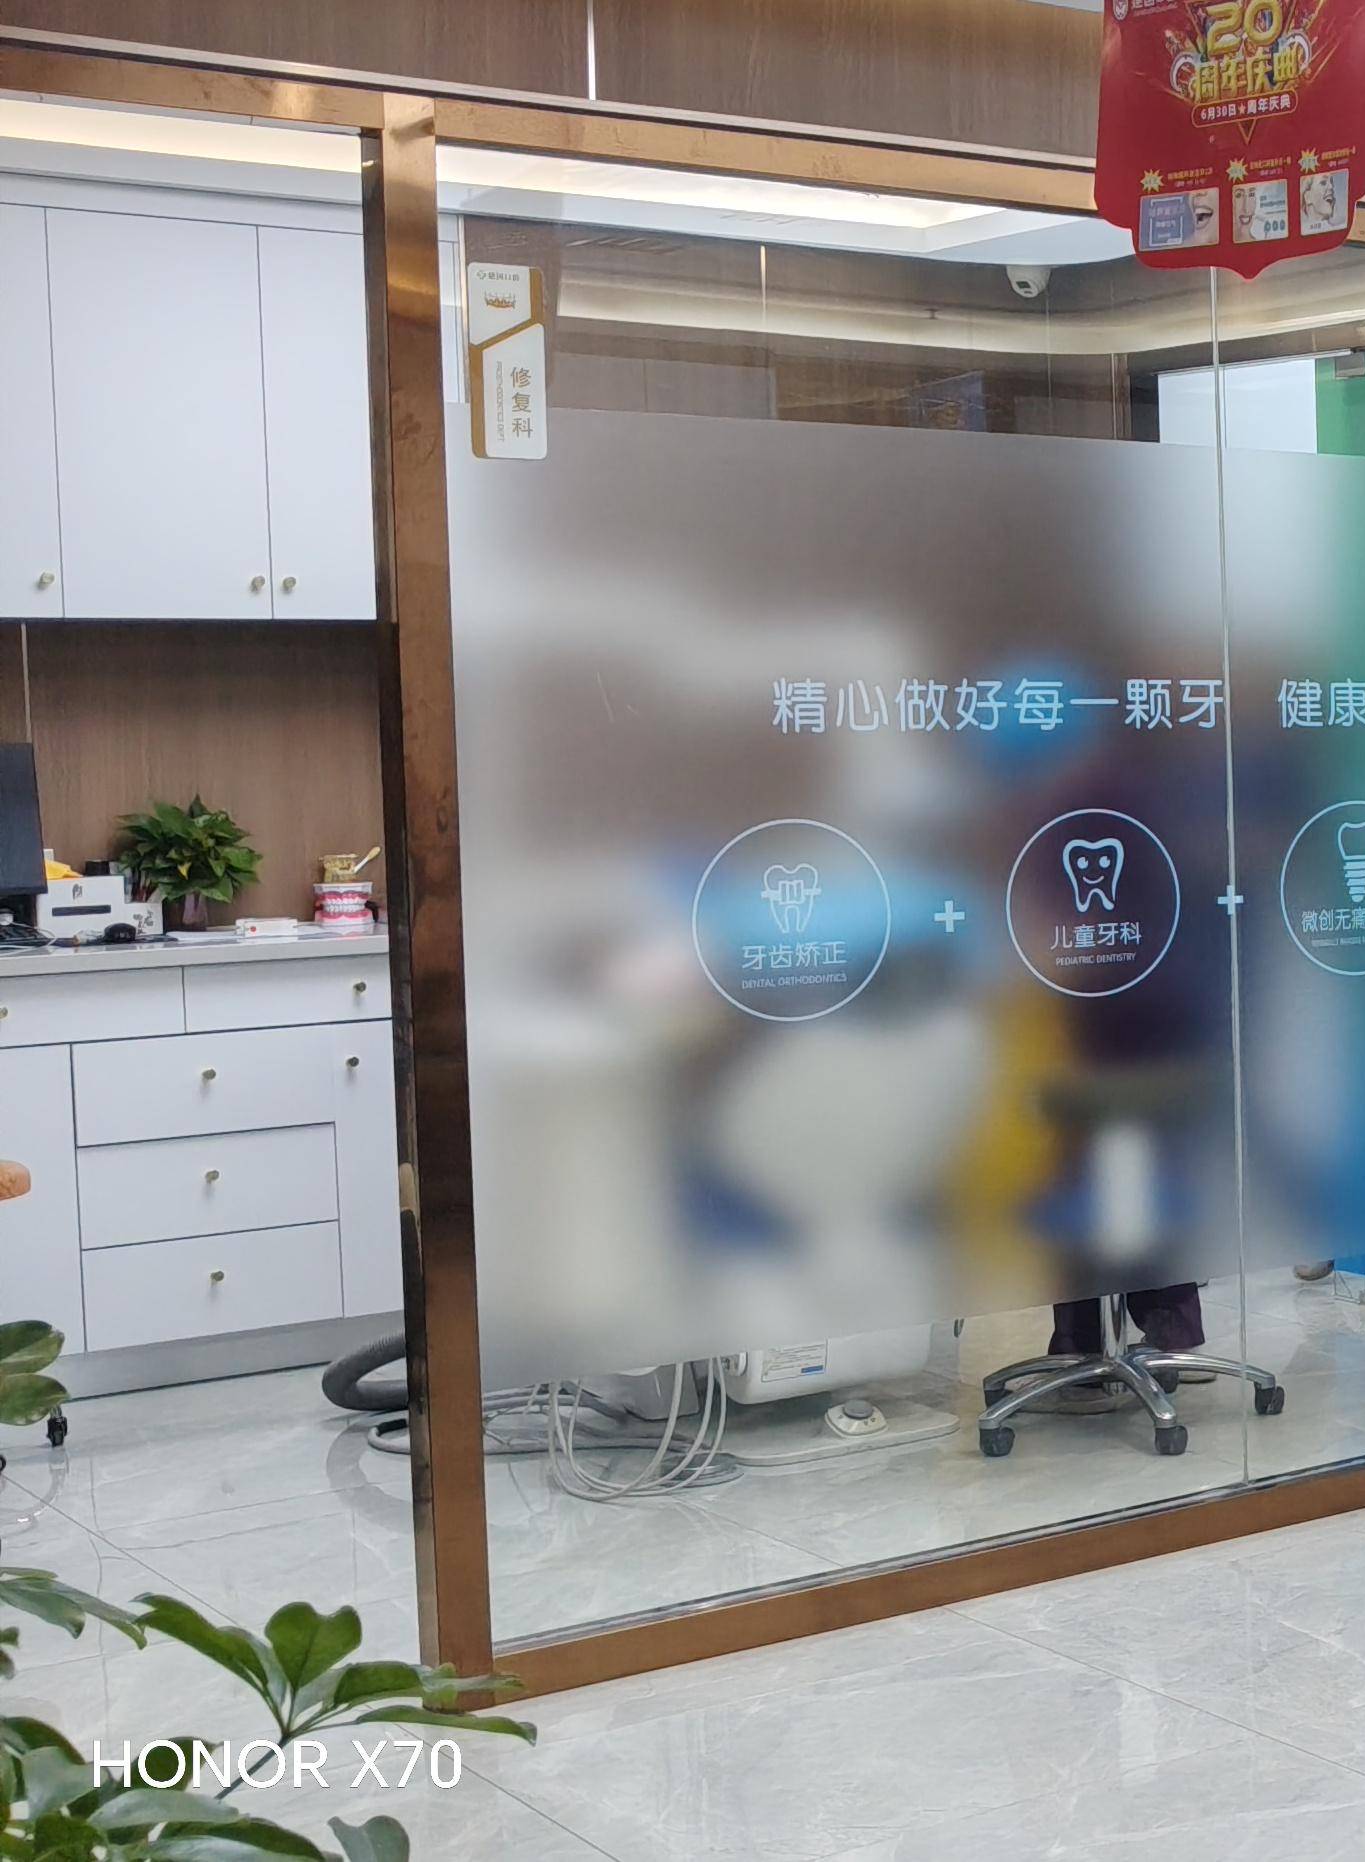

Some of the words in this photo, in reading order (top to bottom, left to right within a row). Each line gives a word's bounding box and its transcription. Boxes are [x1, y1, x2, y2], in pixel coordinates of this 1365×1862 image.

[1206, 0, 1284, 55] 20
[1191, 44, 1301, 102] 周年庆典
[1247, 94, 1291, 114] 周年庆典
[510, 366, 533, 438] 修复科
[772, 679, 1224, 733] 精心做好每一颗牙
[1050, 921, 1142, 950] 儿童牙科
[741, 942, 848, 970] 牙齿矫正
[1055, 957, 1094, 966] PEDIATRIC
[1097, 952, 1136, 963] DENTISTRY
[742, 979, 776, 989] DENTAL
[778, 973, 847, 986] ORTHODONTICS
